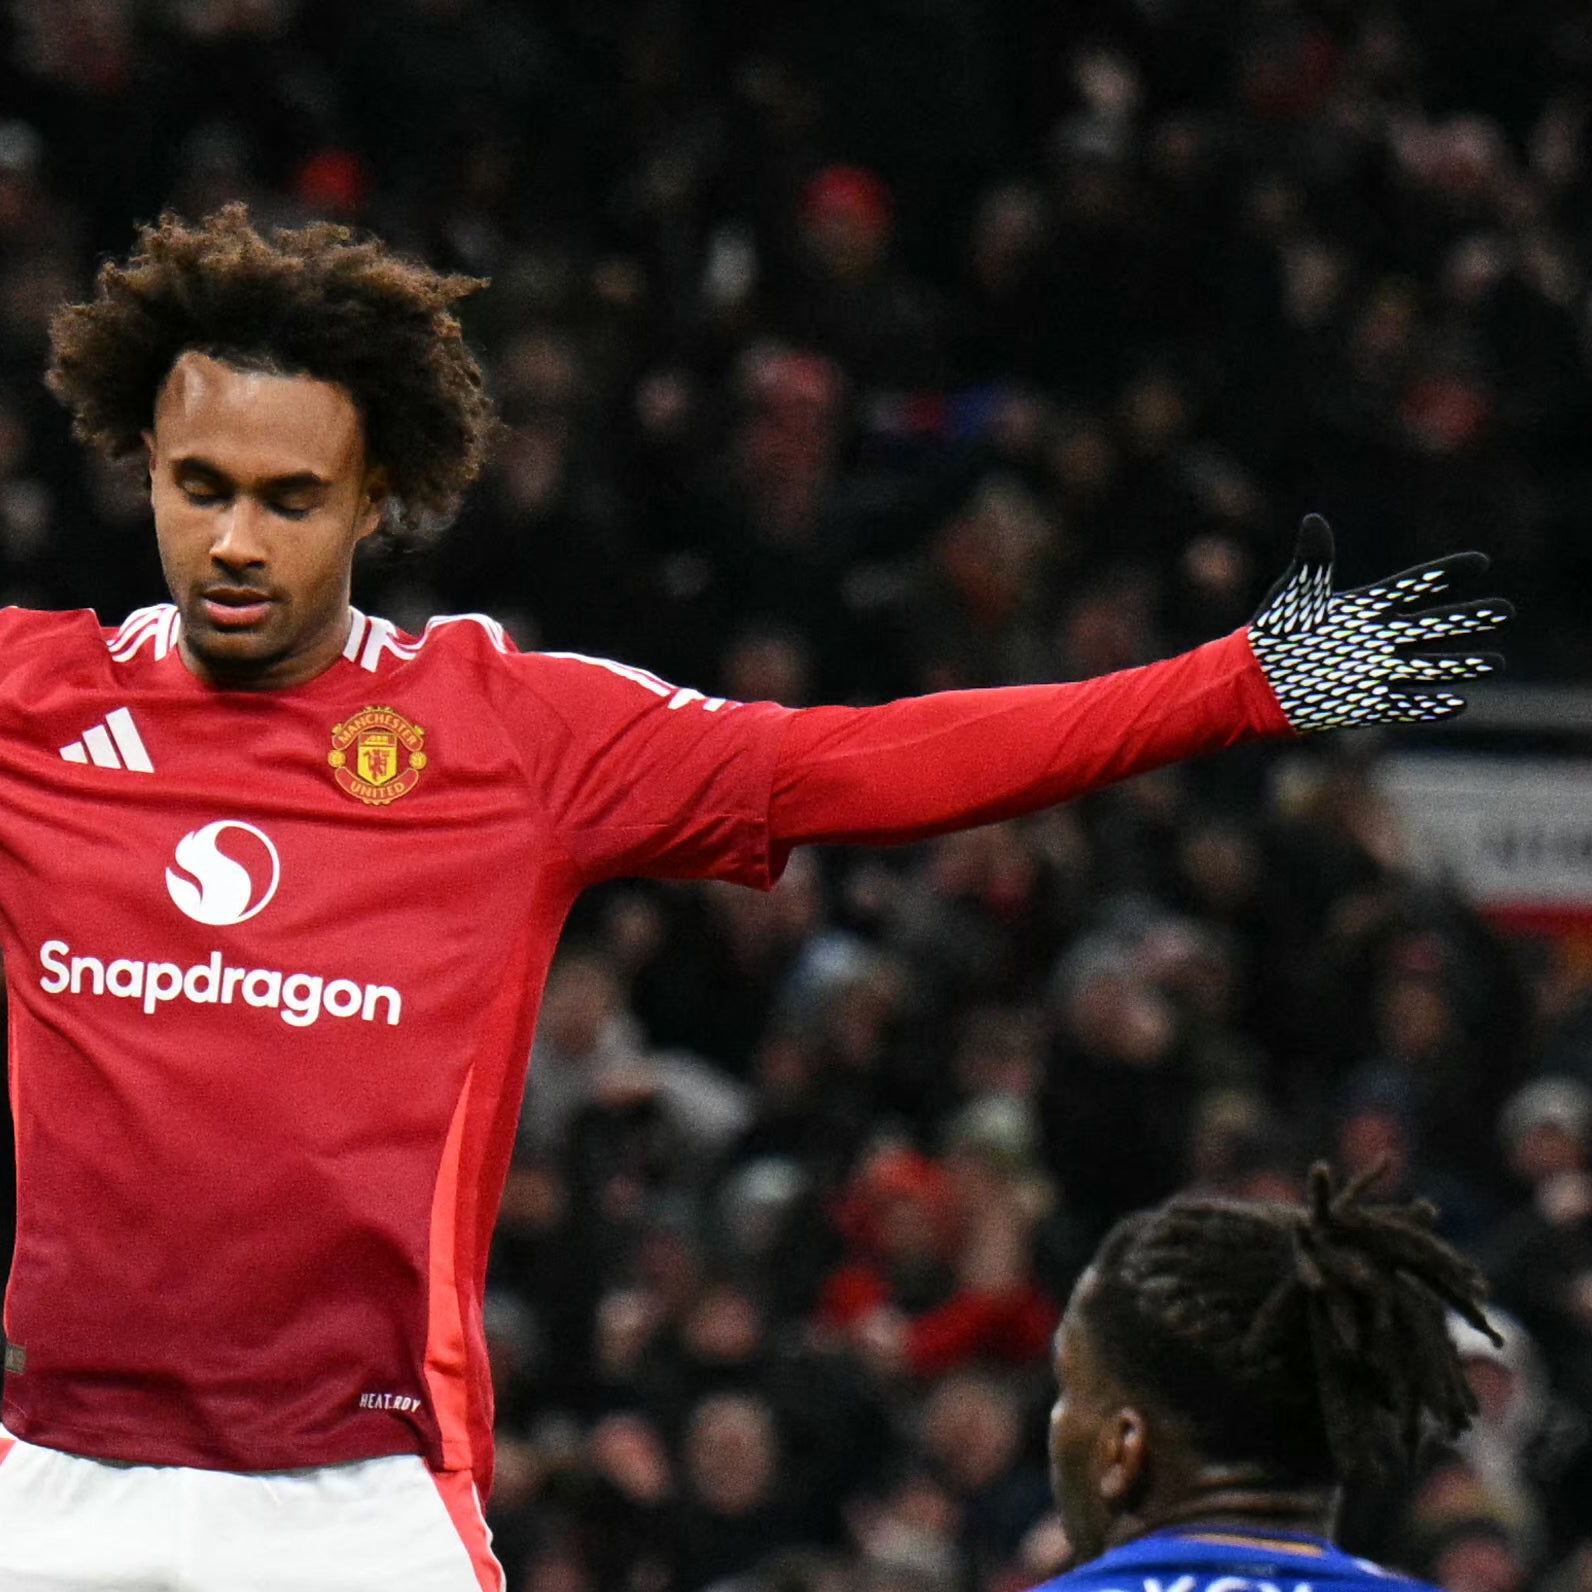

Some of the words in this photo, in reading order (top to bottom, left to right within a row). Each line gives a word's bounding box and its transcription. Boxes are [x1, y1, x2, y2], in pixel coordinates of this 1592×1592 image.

[339, 714, 418, 744] MANCHESTER
[351, 782, 404, 798] UNITED
[39, 940, 402, 1027] Snapdragon
